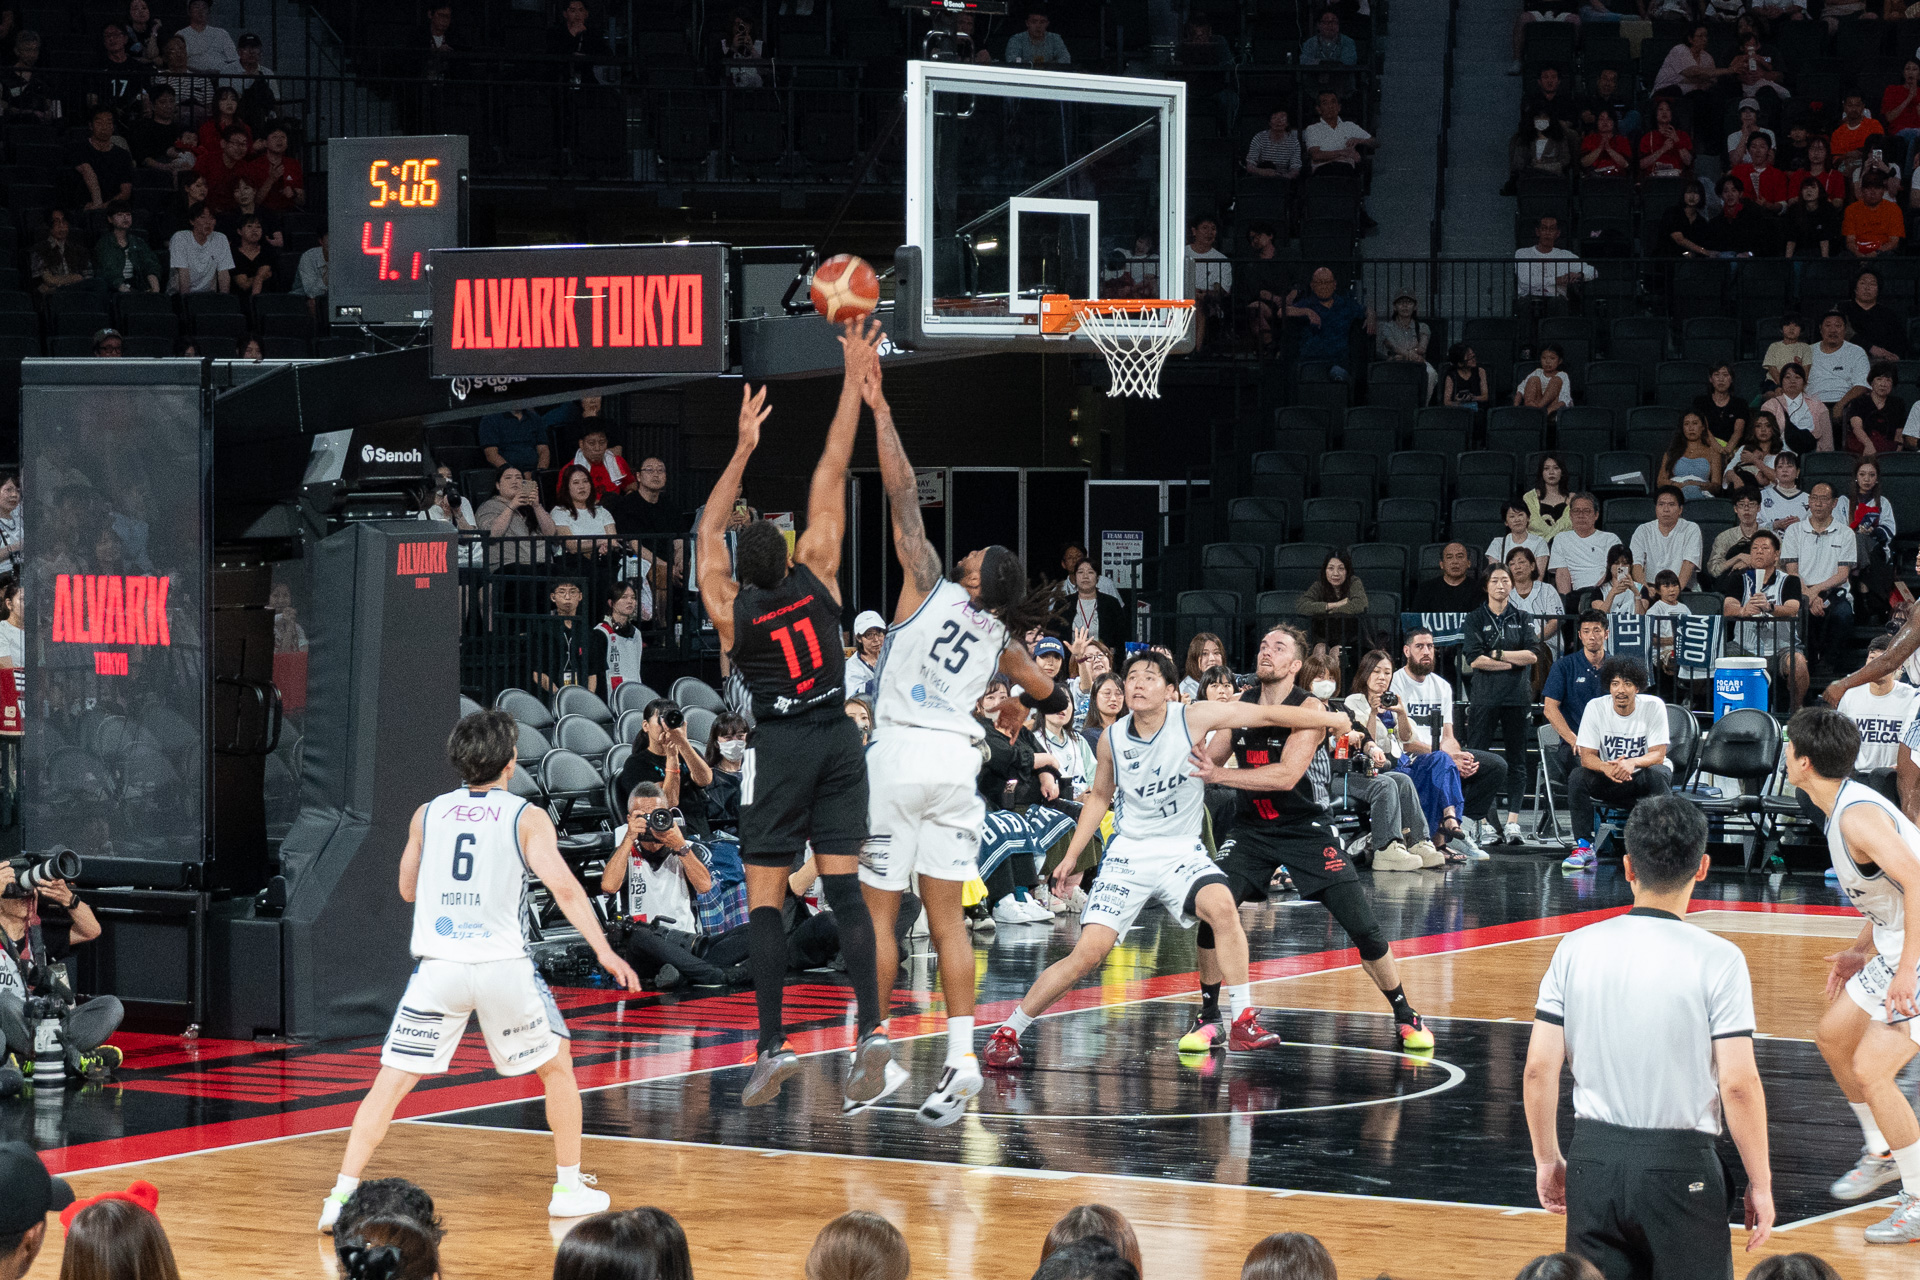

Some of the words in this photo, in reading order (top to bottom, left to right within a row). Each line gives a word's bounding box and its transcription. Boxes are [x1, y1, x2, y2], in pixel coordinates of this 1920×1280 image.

[111, 79, 129, 97] 17
[369, 158, 440, 208] 5:06
[451, 277, 580, 349] ALVARK
[585, 274, 703, 347] TOKYO
[375, 448, 422, 462] Senoh
[397, 541, 448, 575] ALVARK
[52, 574, 171, 646] ALVARK
[770, 617, 823, 680] 11
[929, 619, 980, 674] 25
[1159, 800, 1178, 818] 17
[451, 832, 477, 882] 6
[441, 892, 481, 906] MORITA
[450, 930, 493, 941] エリエール
[0, 973, 19, 988] 00
[394, 1023, 441, 1040] Arromic
